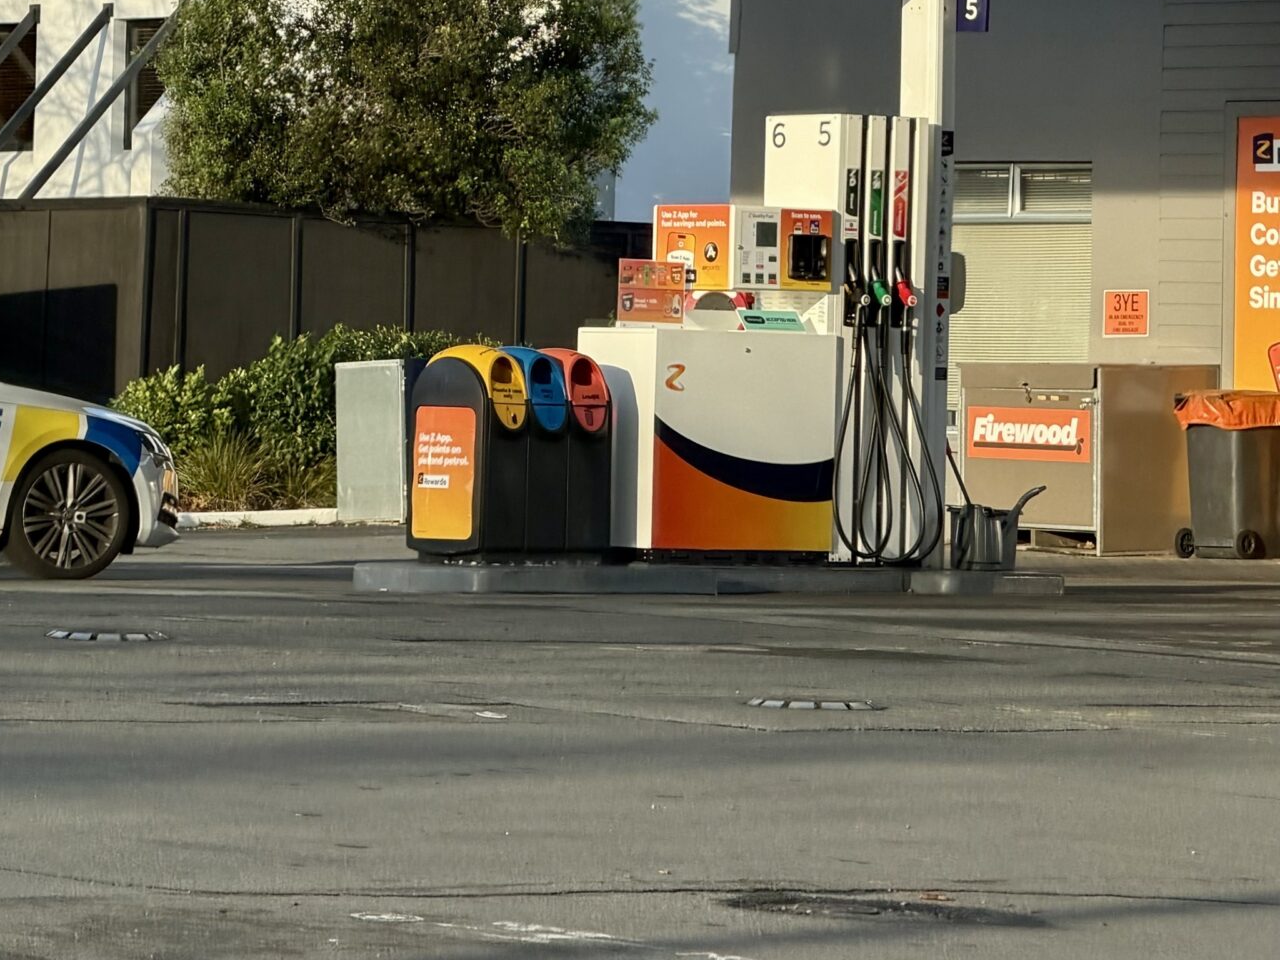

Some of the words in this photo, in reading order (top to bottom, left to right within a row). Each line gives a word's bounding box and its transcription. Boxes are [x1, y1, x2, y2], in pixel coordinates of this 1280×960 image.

[772, 122, 787, 149] 6
[818, 121, 832, 147] 5
[1251, 190, 1280, 214] Bu
[1250, 222, 1280, 246] Co
[1113, 293, 1139, 312] 3YE
[972, 413, 1079, 446] Firewood
